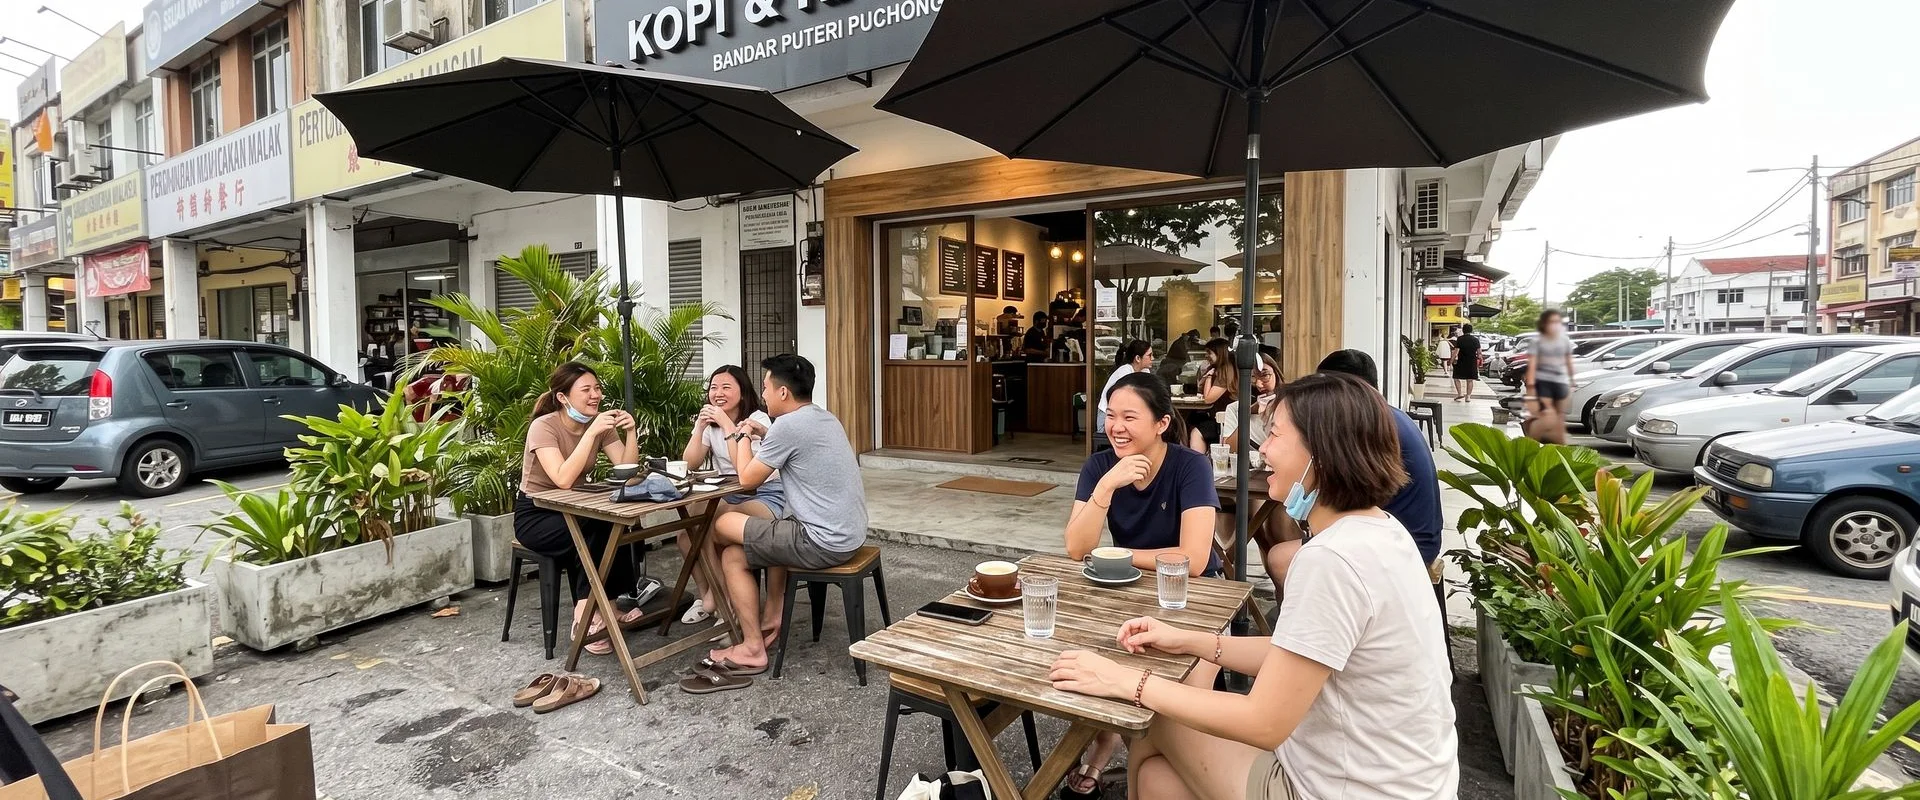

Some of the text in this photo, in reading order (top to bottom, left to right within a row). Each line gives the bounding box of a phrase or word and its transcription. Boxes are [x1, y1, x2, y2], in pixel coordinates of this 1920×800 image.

[628, 0, 725, 60] KOPI
[713, 38, 778, 72] BANDAR
[781, 19, 844, 53] PUTERI
[248, 123, 282, 166] MALAK
